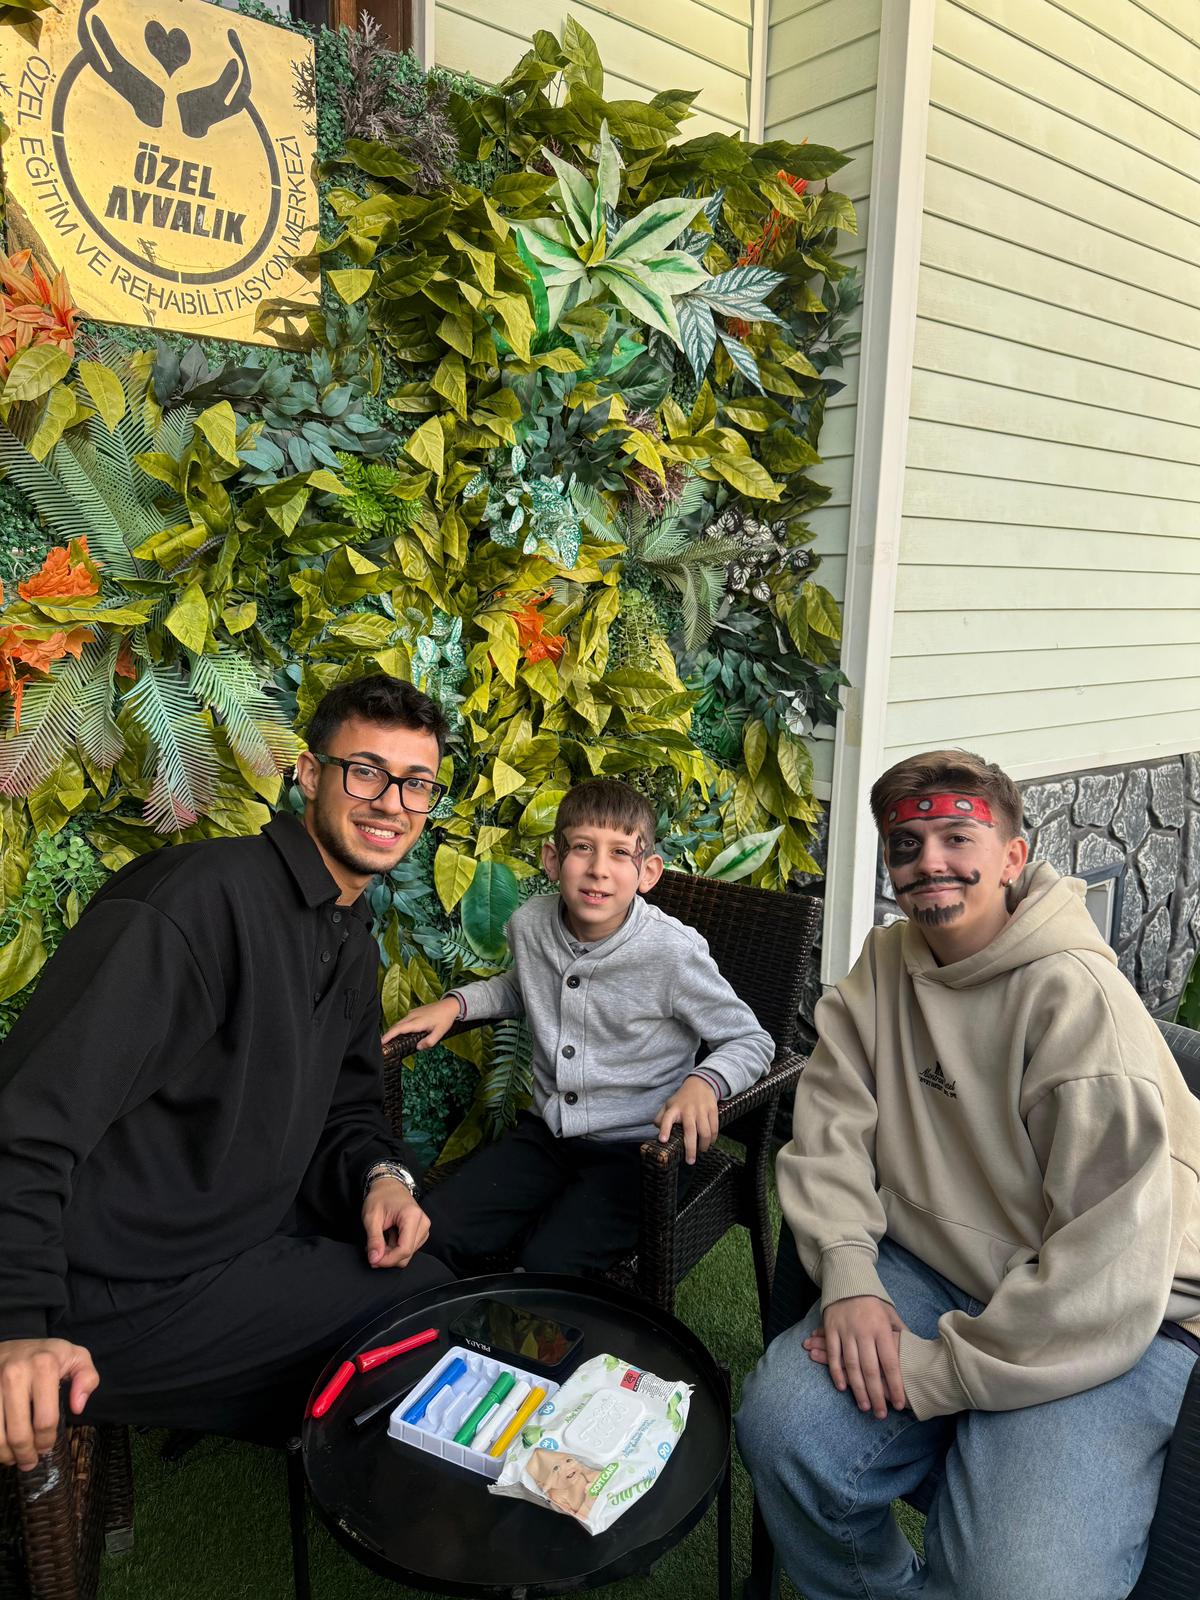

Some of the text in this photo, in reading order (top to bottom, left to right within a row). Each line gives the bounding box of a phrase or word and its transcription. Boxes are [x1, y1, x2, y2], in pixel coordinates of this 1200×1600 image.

[18, 56, 307, 316] ÖZEL EĞİTİM VE REHABİLİTASYON MERKEZİ
[134, 141, 216, 200] ÖZEL
[104, 185, 247, 245] AYVALIK
[465, 1338, 491, 1352] PRADA
[659, 1444, 671, 1458] 90
[590, 1463, 617, 1495] SOFT CARE
